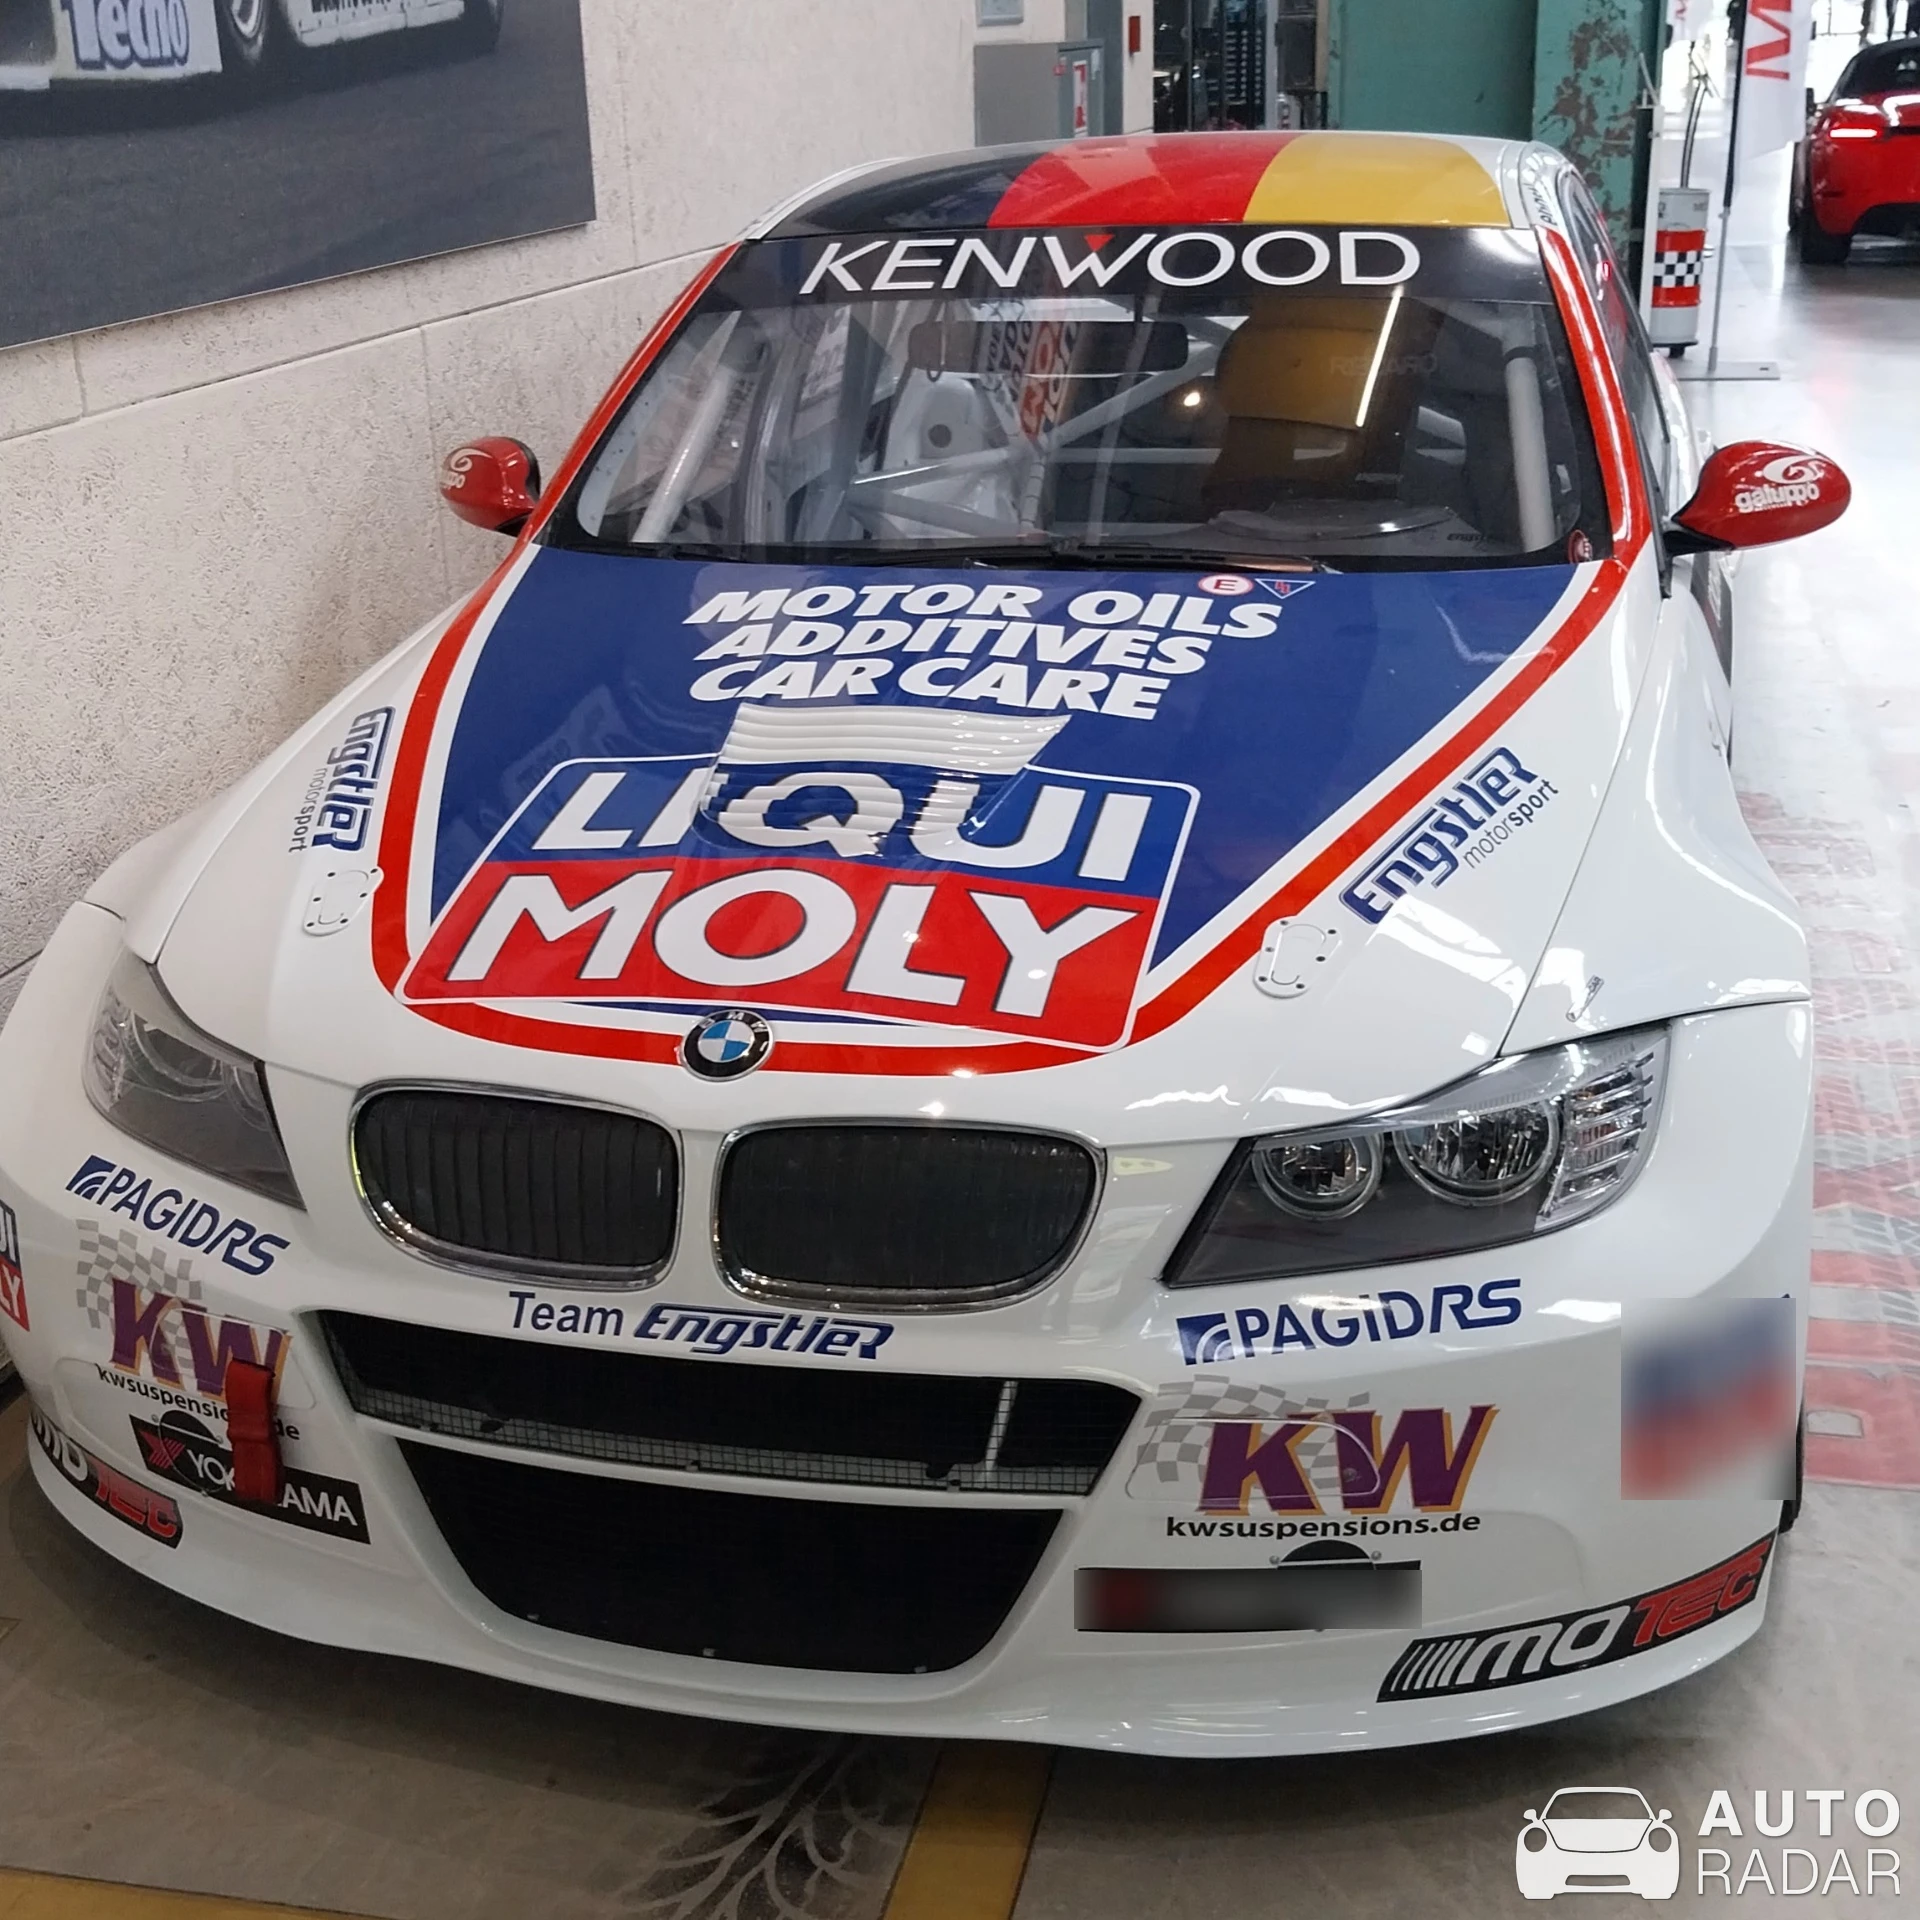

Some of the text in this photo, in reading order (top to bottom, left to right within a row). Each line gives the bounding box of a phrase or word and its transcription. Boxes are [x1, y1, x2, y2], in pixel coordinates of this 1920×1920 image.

[800, 231, 1421, 295] KENWOOD
[682, 583, 1283, 639] MOTOR OILS
[1213, 579, 1237, 591] E
[693, 619, 1213, 675] ADDITIVES
[689, 657, 1170, 720] CAR CARE
[288, 767, 328, 853] motorsport
[532, 770, 1153, 880] LIQUI
[1462, 779, 1560, 869] motorsport
[447, 868, 1143, 1018] MOLY
[109, 1278, 293, 1402] KW
[508, 1291, 624, 1337] Team
[187, 1449, 358, 1527] YOKAMA
[1195, 1404, 1500, 1516] KW
[1165, 1513, 1481, 1541] kwsuspensions.de
